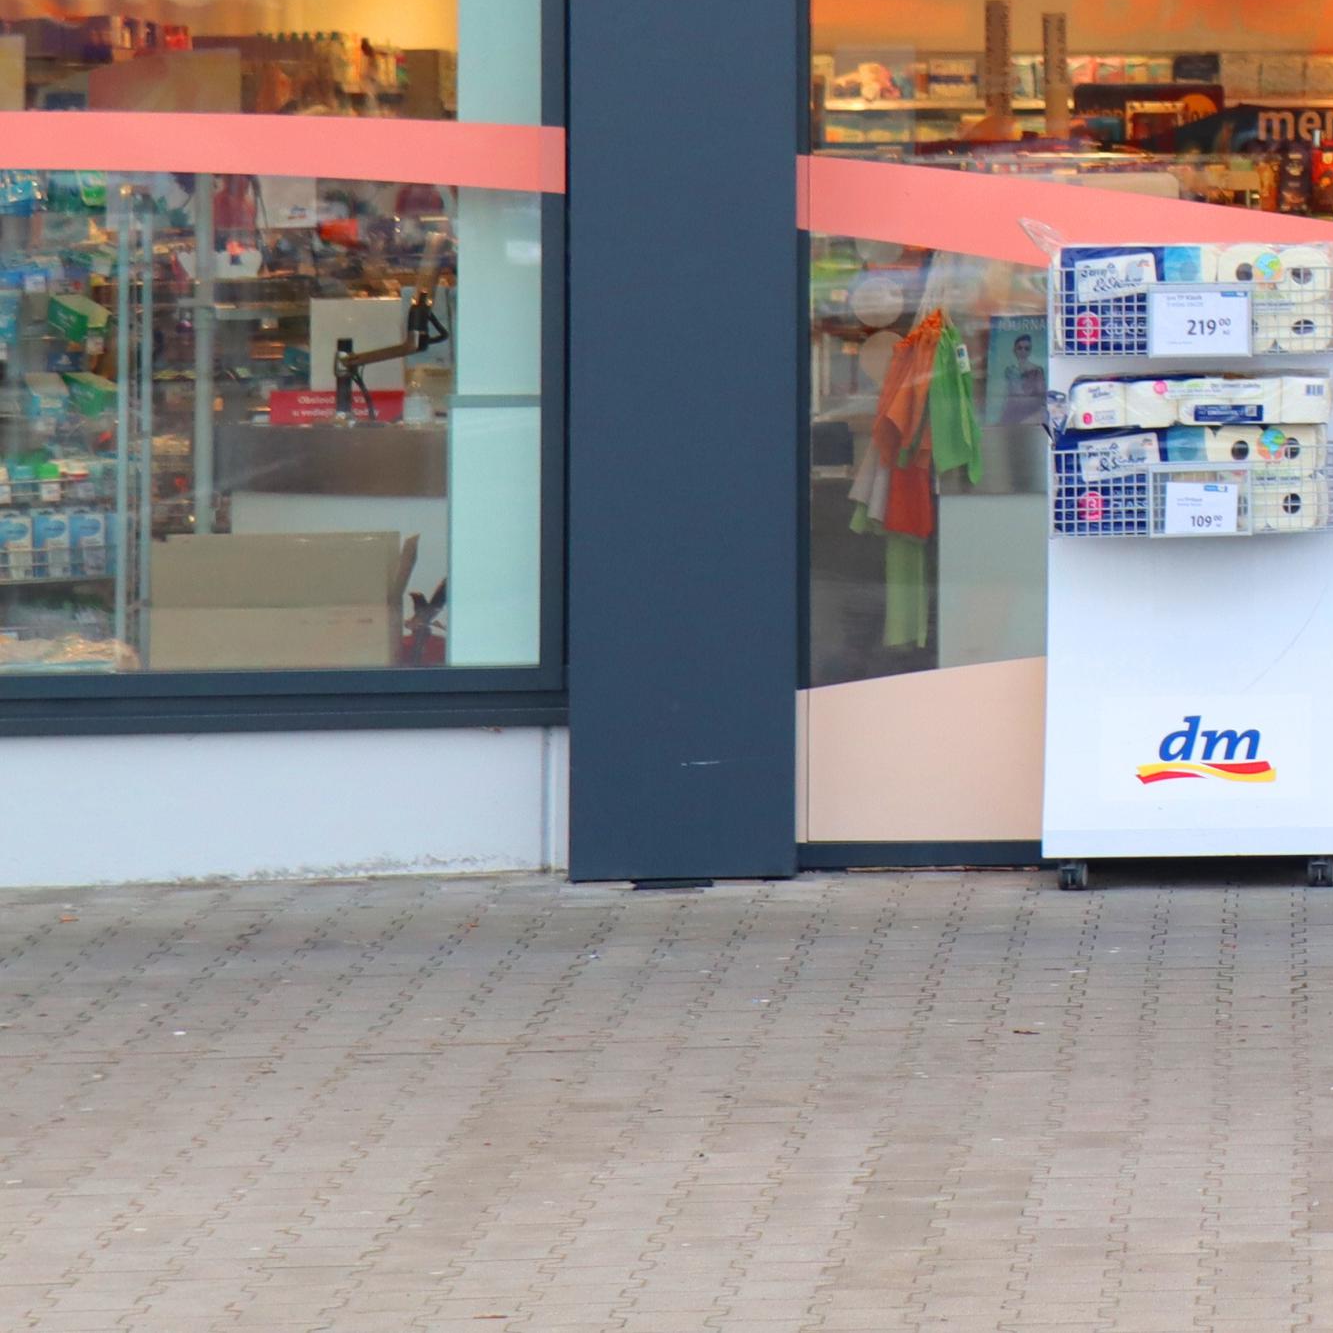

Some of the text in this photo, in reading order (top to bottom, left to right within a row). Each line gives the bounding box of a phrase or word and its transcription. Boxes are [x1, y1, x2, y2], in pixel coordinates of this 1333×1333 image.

[1186, 318, 1231, 336] 219 00
[1190, 515, 1213, 528] 109
[1158, 715, 1261, 762] dm
